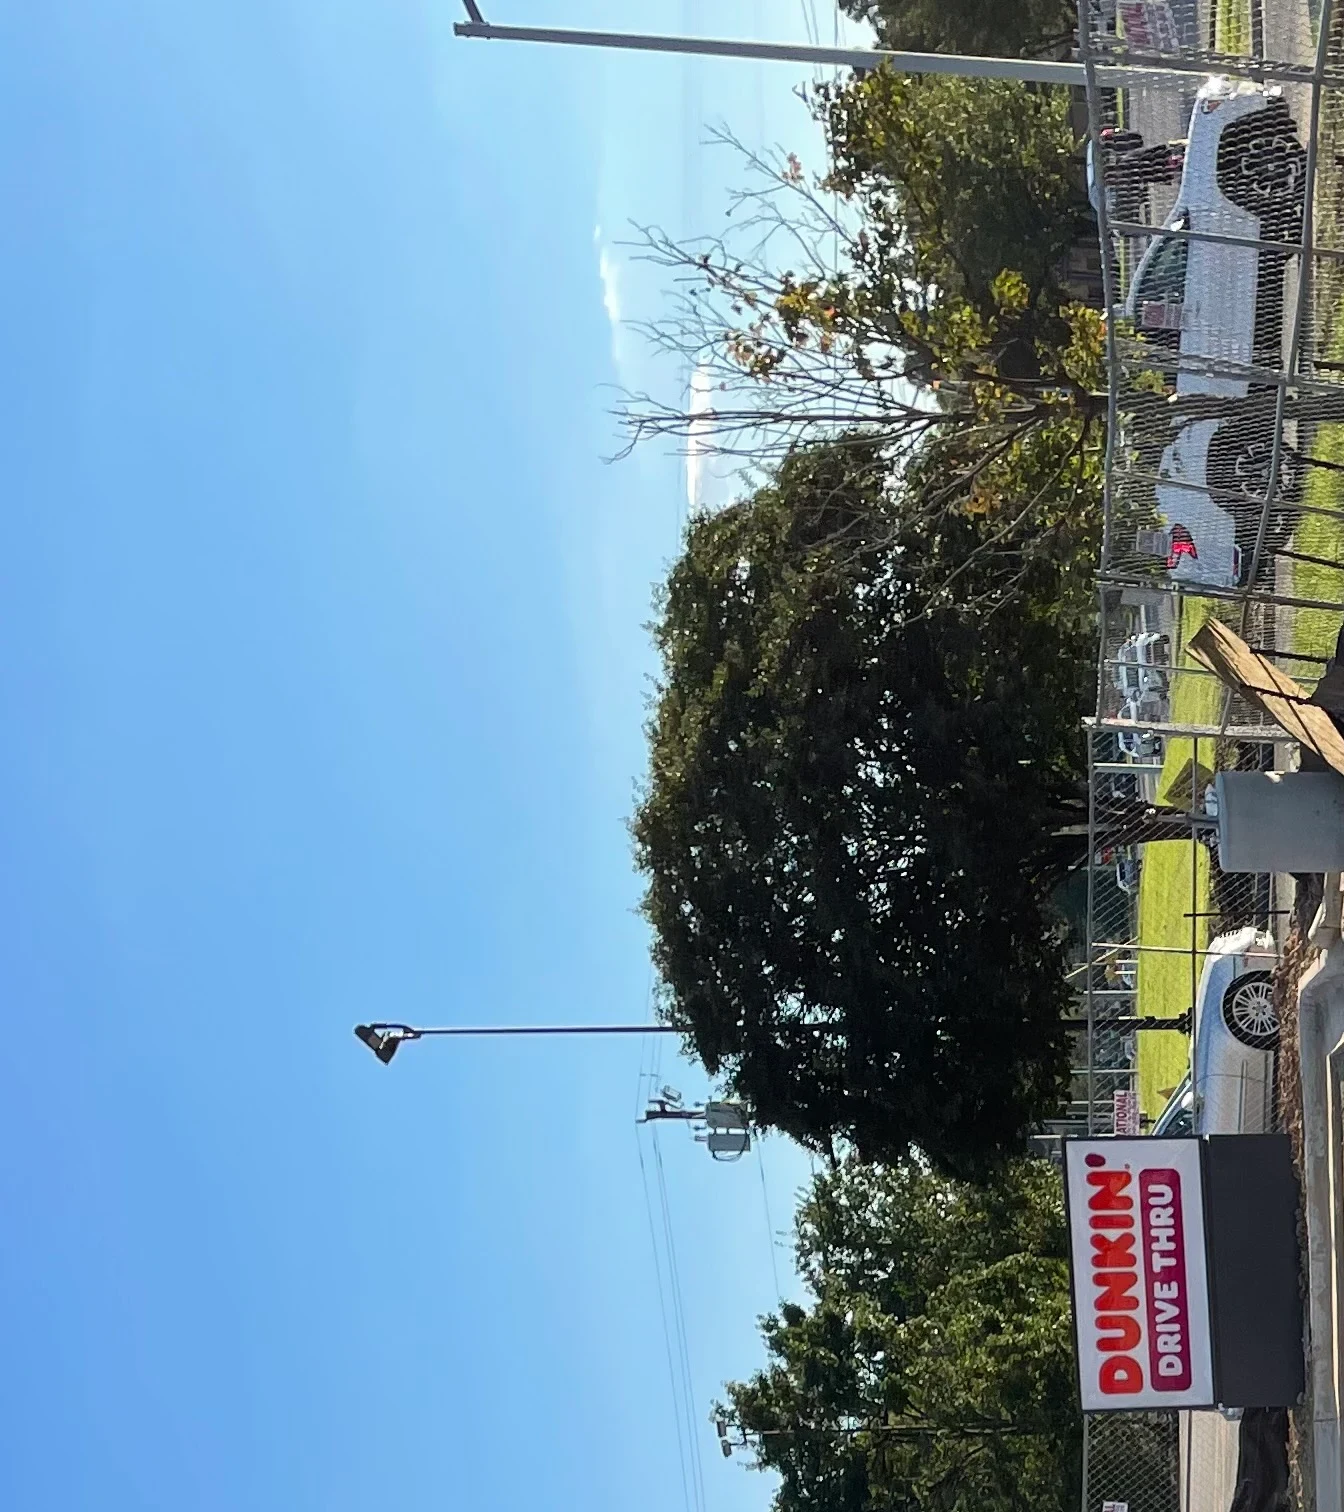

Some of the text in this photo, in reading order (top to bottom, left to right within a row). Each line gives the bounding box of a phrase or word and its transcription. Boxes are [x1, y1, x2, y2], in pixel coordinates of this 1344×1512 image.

[1115, 1092, 1128, 1134] ATIONAL
[1084, 1153, 1143, 1395] DUNKIN'
[1147, 1184, 1183, 1377] DRIVE THRU
